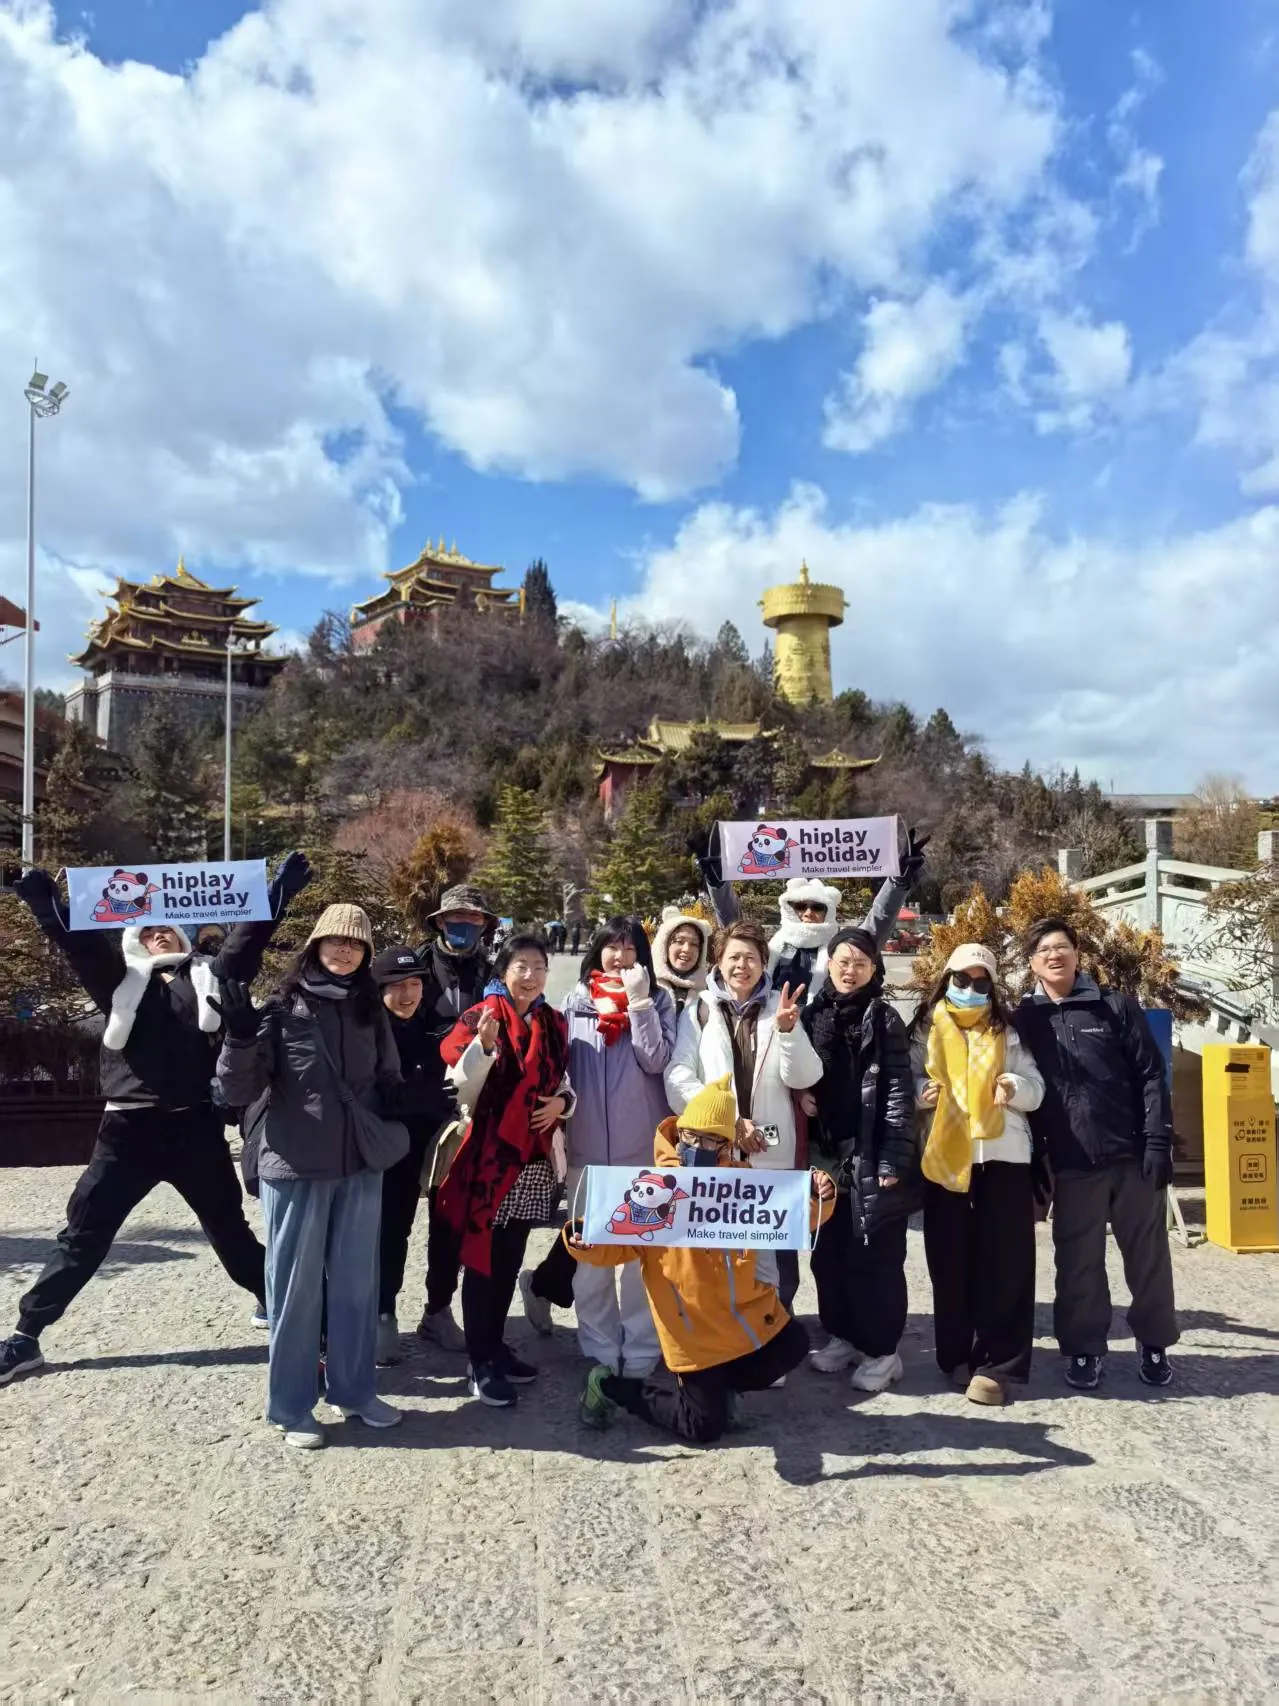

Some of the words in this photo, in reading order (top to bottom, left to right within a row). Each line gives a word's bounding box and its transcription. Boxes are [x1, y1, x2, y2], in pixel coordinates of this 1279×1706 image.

[799, 827, 868, 847] hiplay
[800, 846, 881, 864] holiday
[801, 866, 824, 874] Make
[851, 864, 883, 874] simpler
[161, 870, 235, 892] hiplay
[163, 891, 249, 909] holiday
[165, 911, 191, 920] Make
[192, 909, 218, 918] travel
[219, 908, 252, 919] simpler
[691, 1176, 774, 1205] hiplay
[688, 1201, 788, 1230] holiday
[687, 1228, 716, 1239] Make
[718, 1229, 747, 1240] travel
[750, 1230, 789, 1243] simpler
